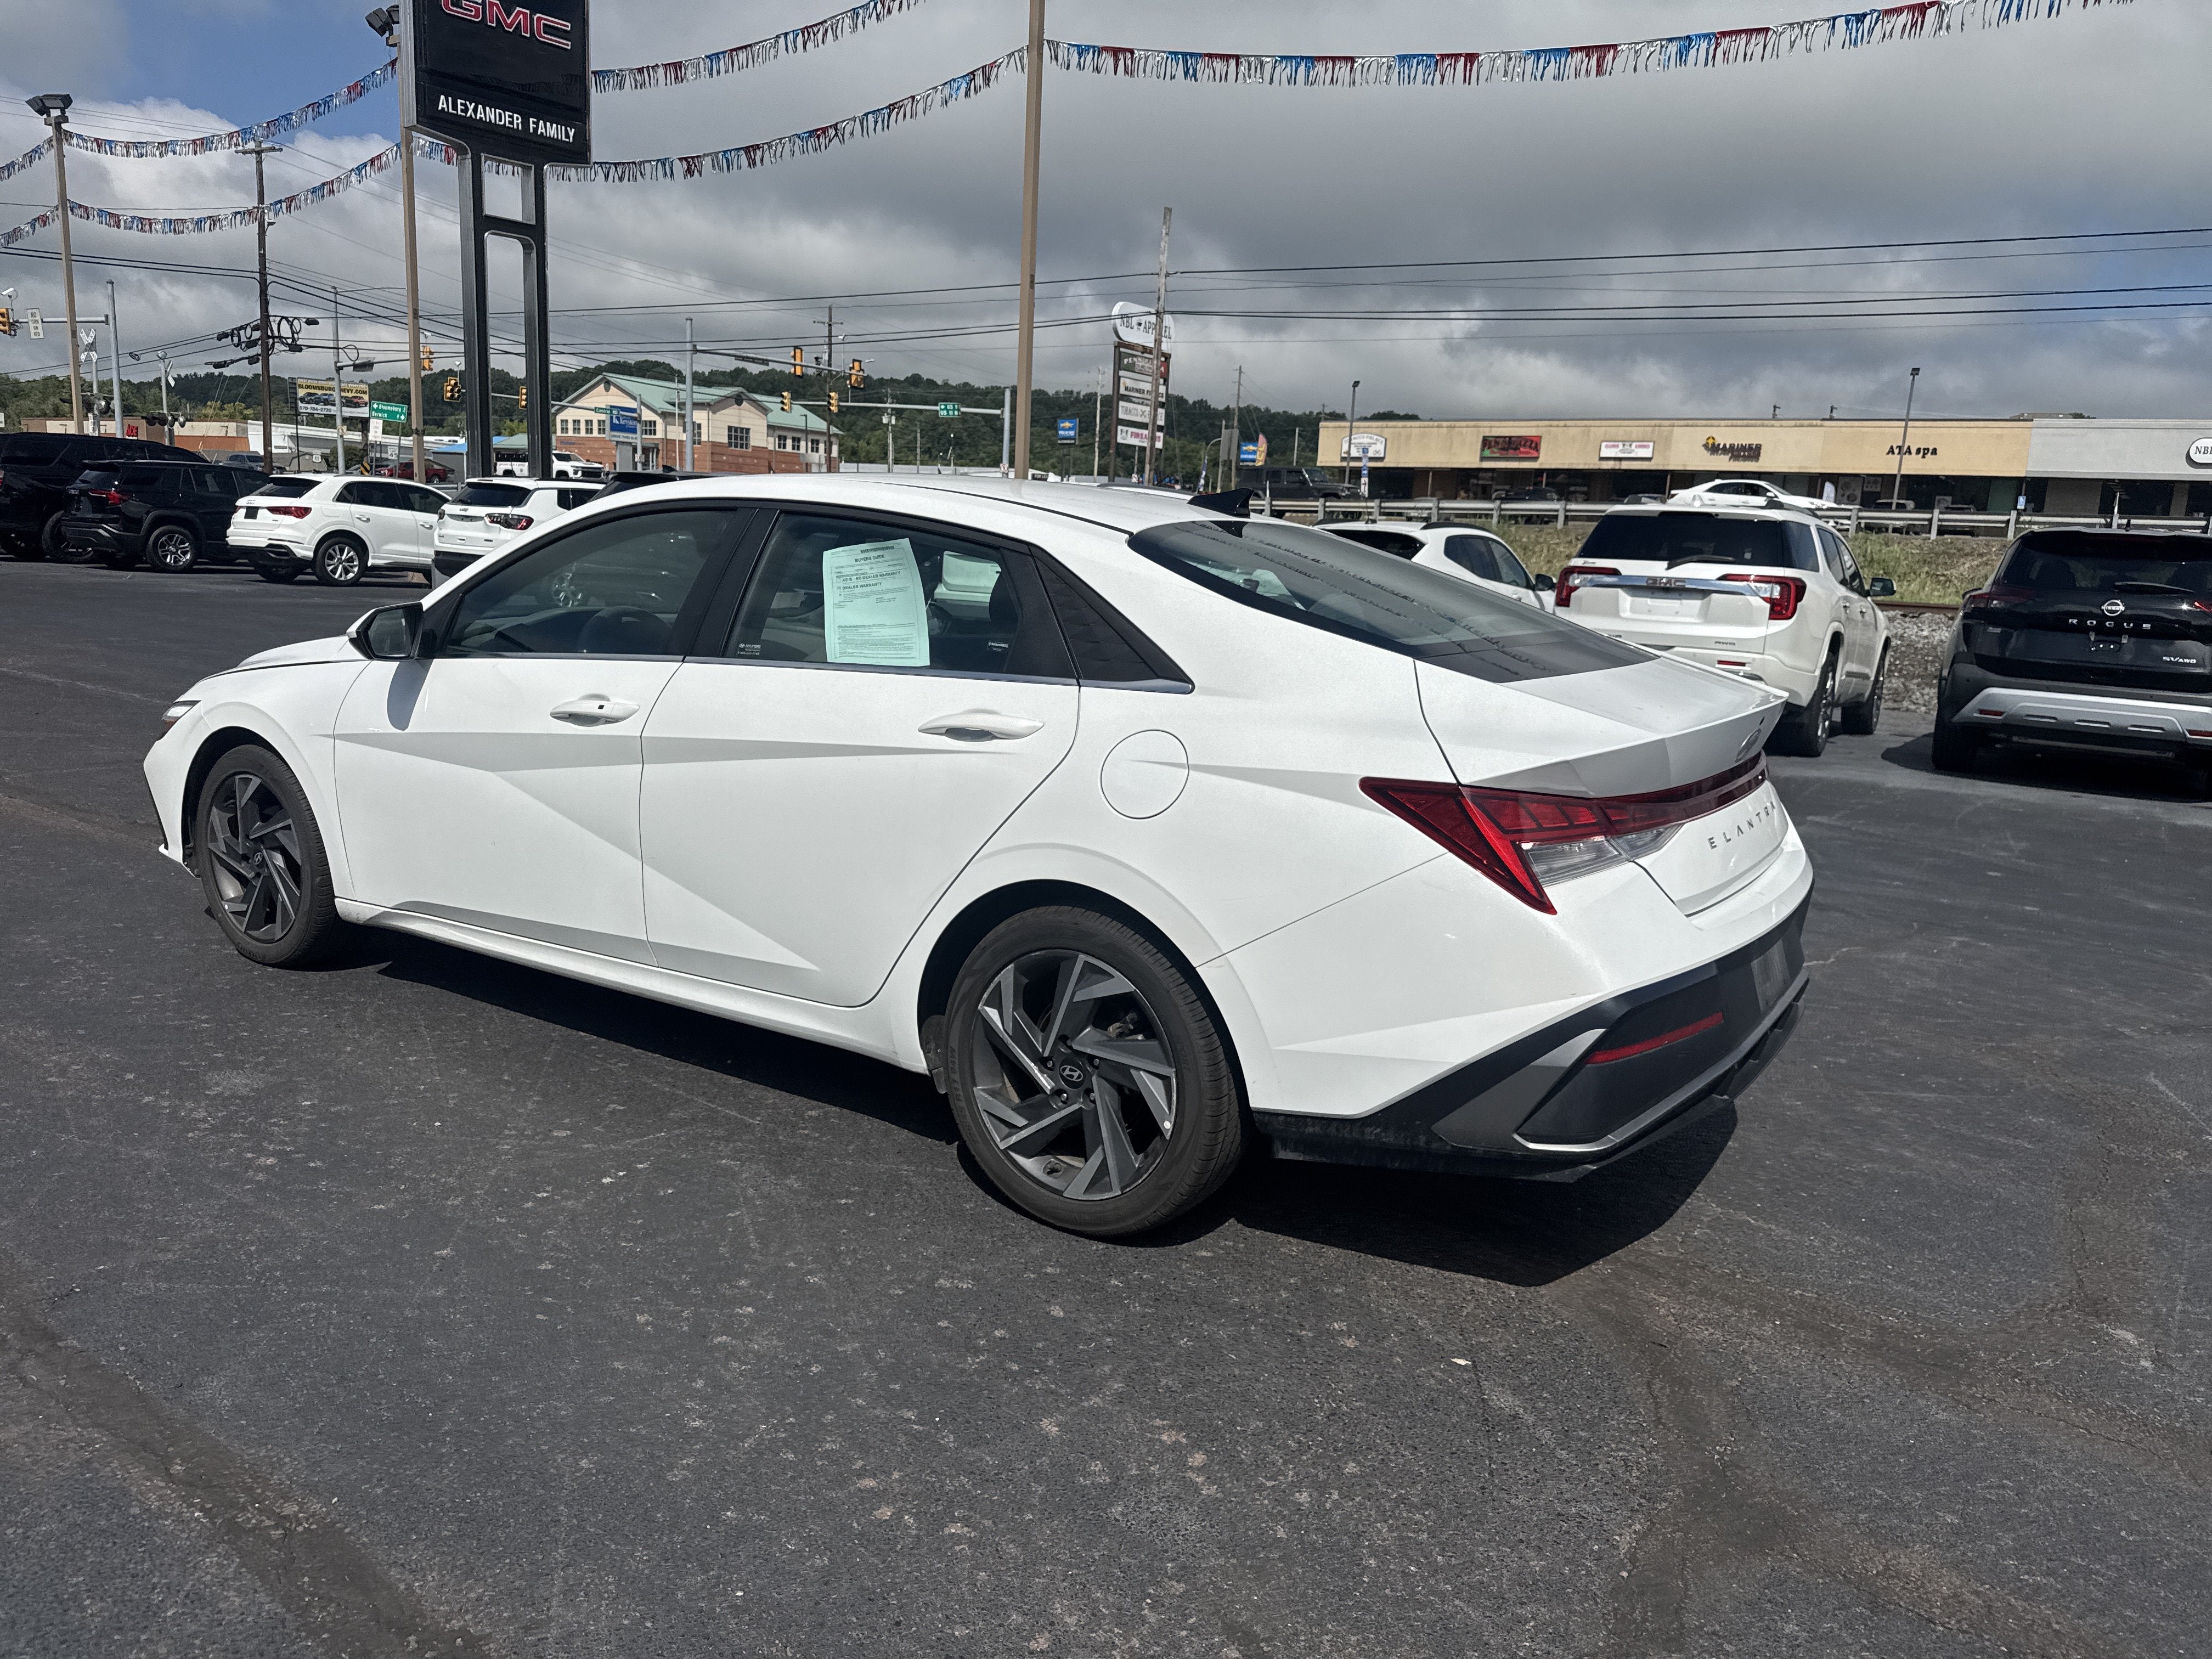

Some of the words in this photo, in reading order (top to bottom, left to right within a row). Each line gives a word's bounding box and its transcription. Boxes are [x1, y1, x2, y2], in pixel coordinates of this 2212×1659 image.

[442, 0, 571, 49] GMC
[438, 94, 522, 131] ALEXANDER
[529, 118, 575, 143] FAMILY
[1120, 315, 1134, 329] NBL
[1143, 320, 1172, 339] APPEL
[298, 383, 368, 394] BLOOMSBURGHEVY.COM
[1125, 386, 1146, 395] MARINER
[379, 404, 402, 413] Bloomsburg
[126, 424, 139, 437] ACE
[1130, 431, 1161, 442] FIREAS
[1886, 445, 1912, 455] ATA
[1915, 447, 1938, 459] spa
[1646, 578, 1686, 588] GMC
[2068, 618, 2151, 630] ROGUE
[1707, 800, 1776, 850] ELANTRA
